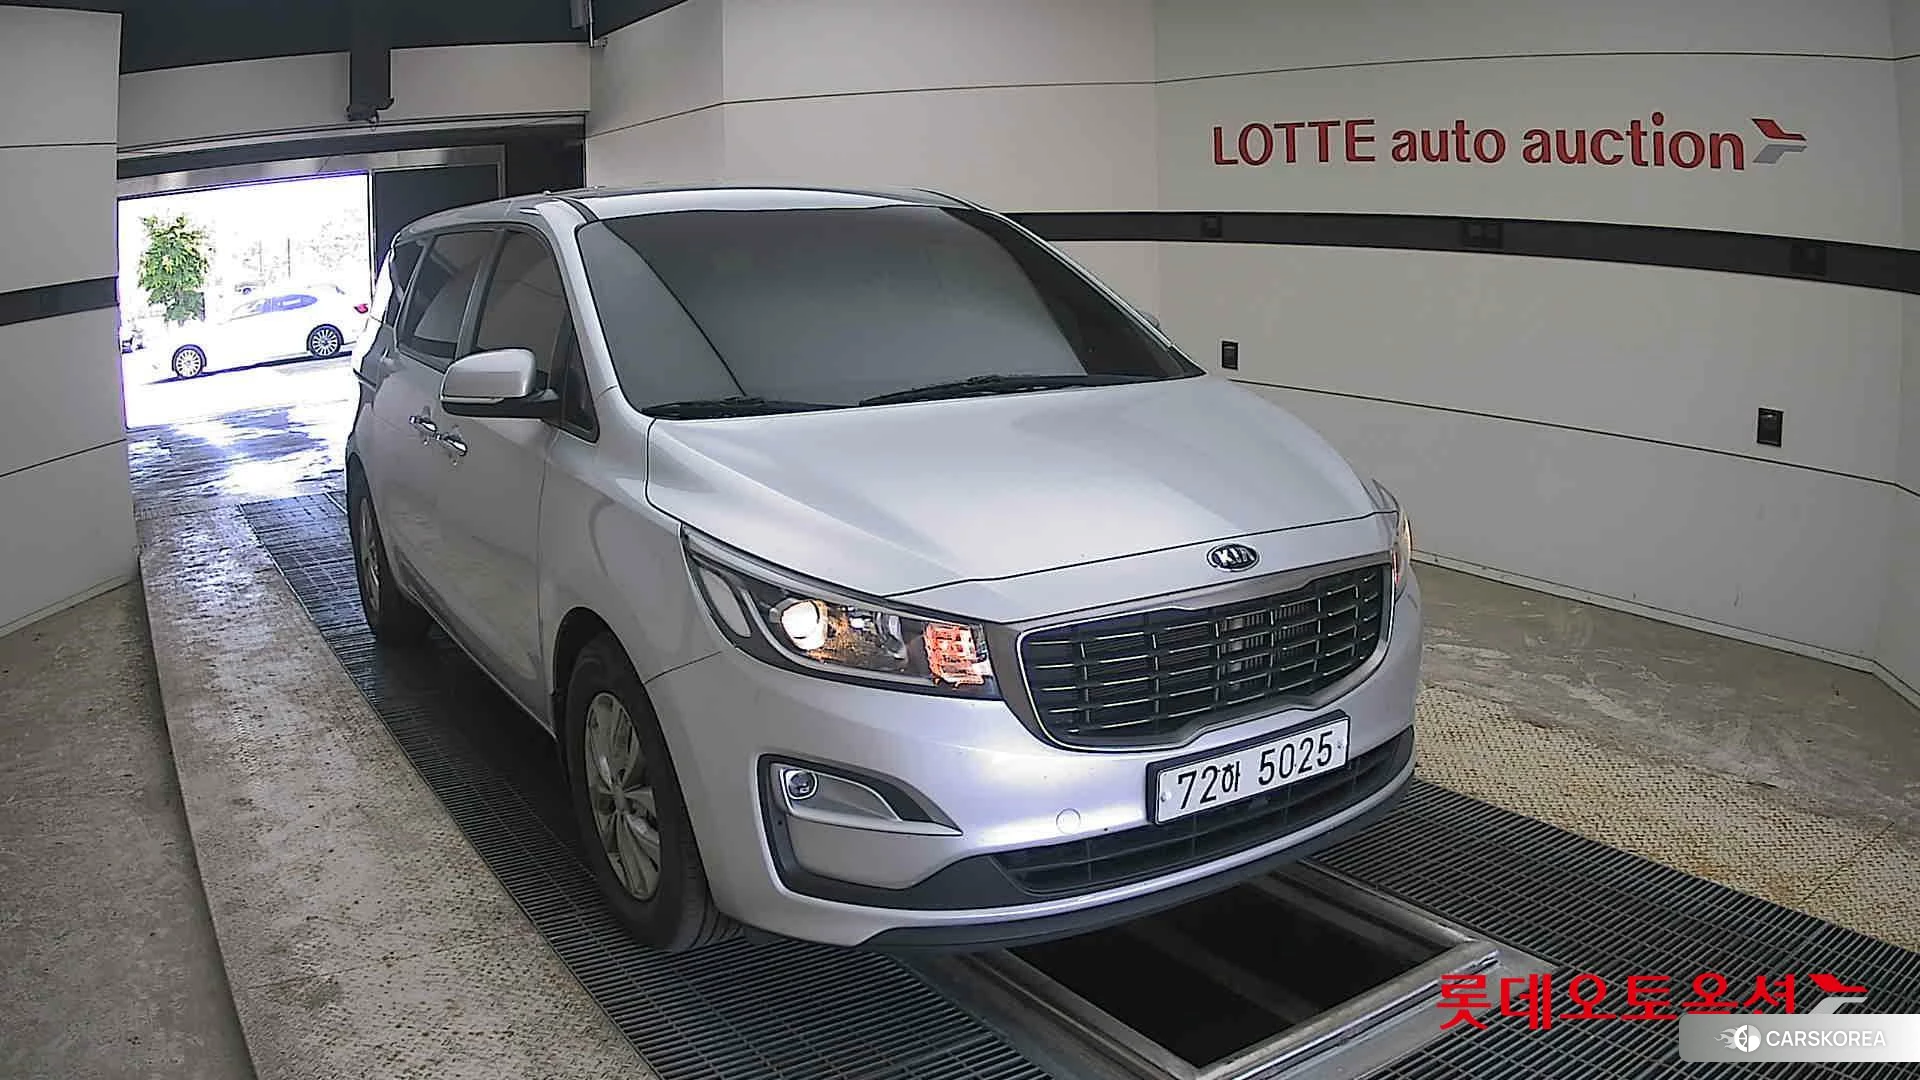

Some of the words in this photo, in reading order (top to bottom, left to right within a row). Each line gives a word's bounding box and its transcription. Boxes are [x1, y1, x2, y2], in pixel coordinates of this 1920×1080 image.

[1213, 118, 1376, 165] LOTTE
[1392, 119, 1507, 164] auto
[1522, 111, 1745, 171] auction
[1211, 547, 1257, 567] KIA
[1177, 761, 1241, 810] 72하
[1258, 730, 1333, 786] 5025
